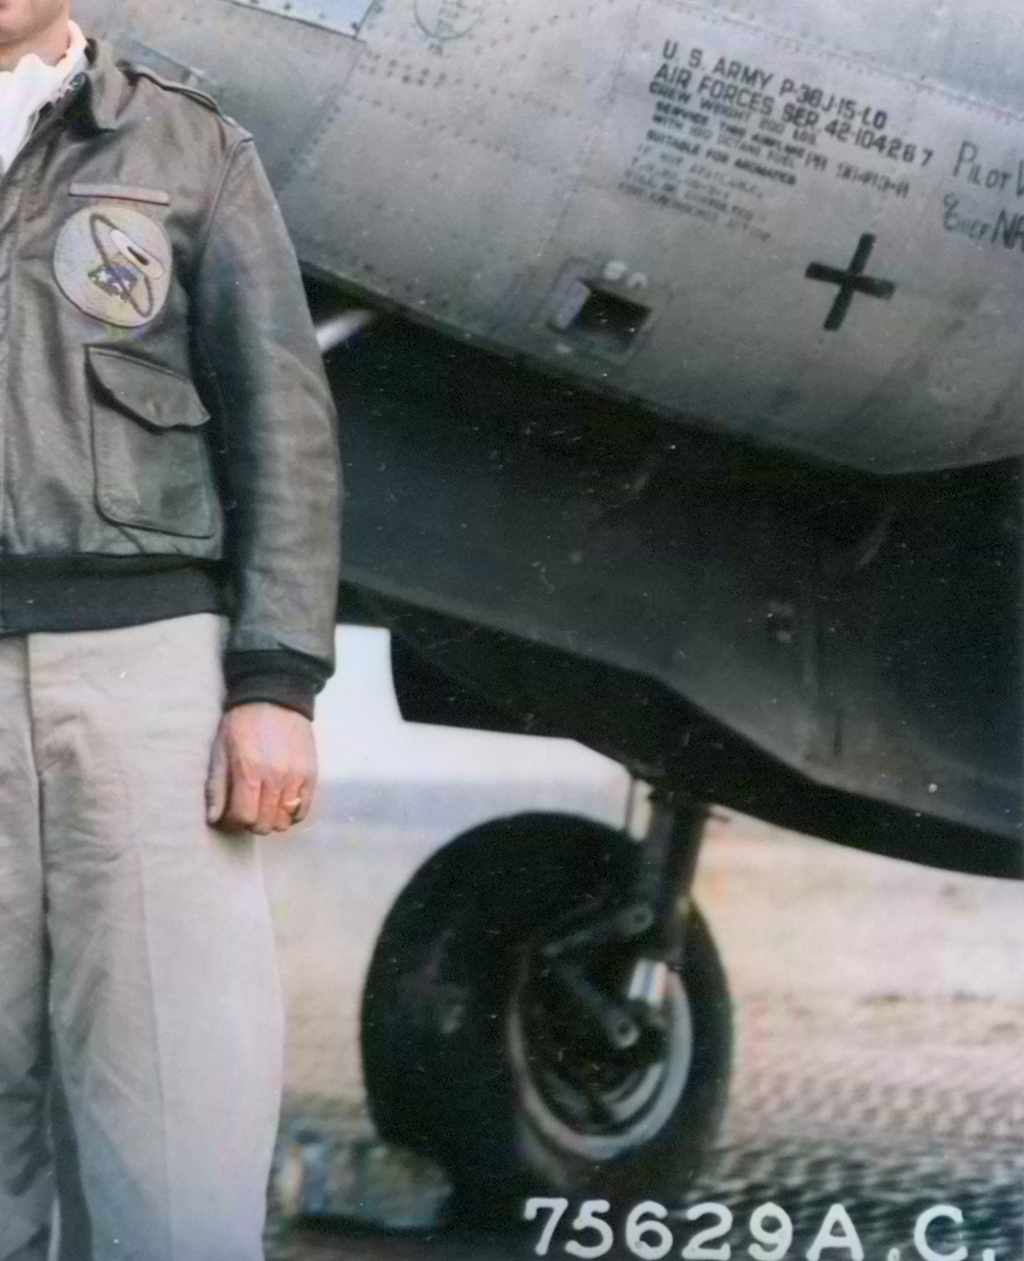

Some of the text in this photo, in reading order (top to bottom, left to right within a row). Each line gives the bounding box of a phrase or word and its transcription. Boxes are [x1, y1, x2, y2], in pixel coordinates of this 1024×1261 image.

[654, 63, 692, 89] AIR
[698, 75, 774, 117] FORCES
[712, 57, 773, 89] ARMY
